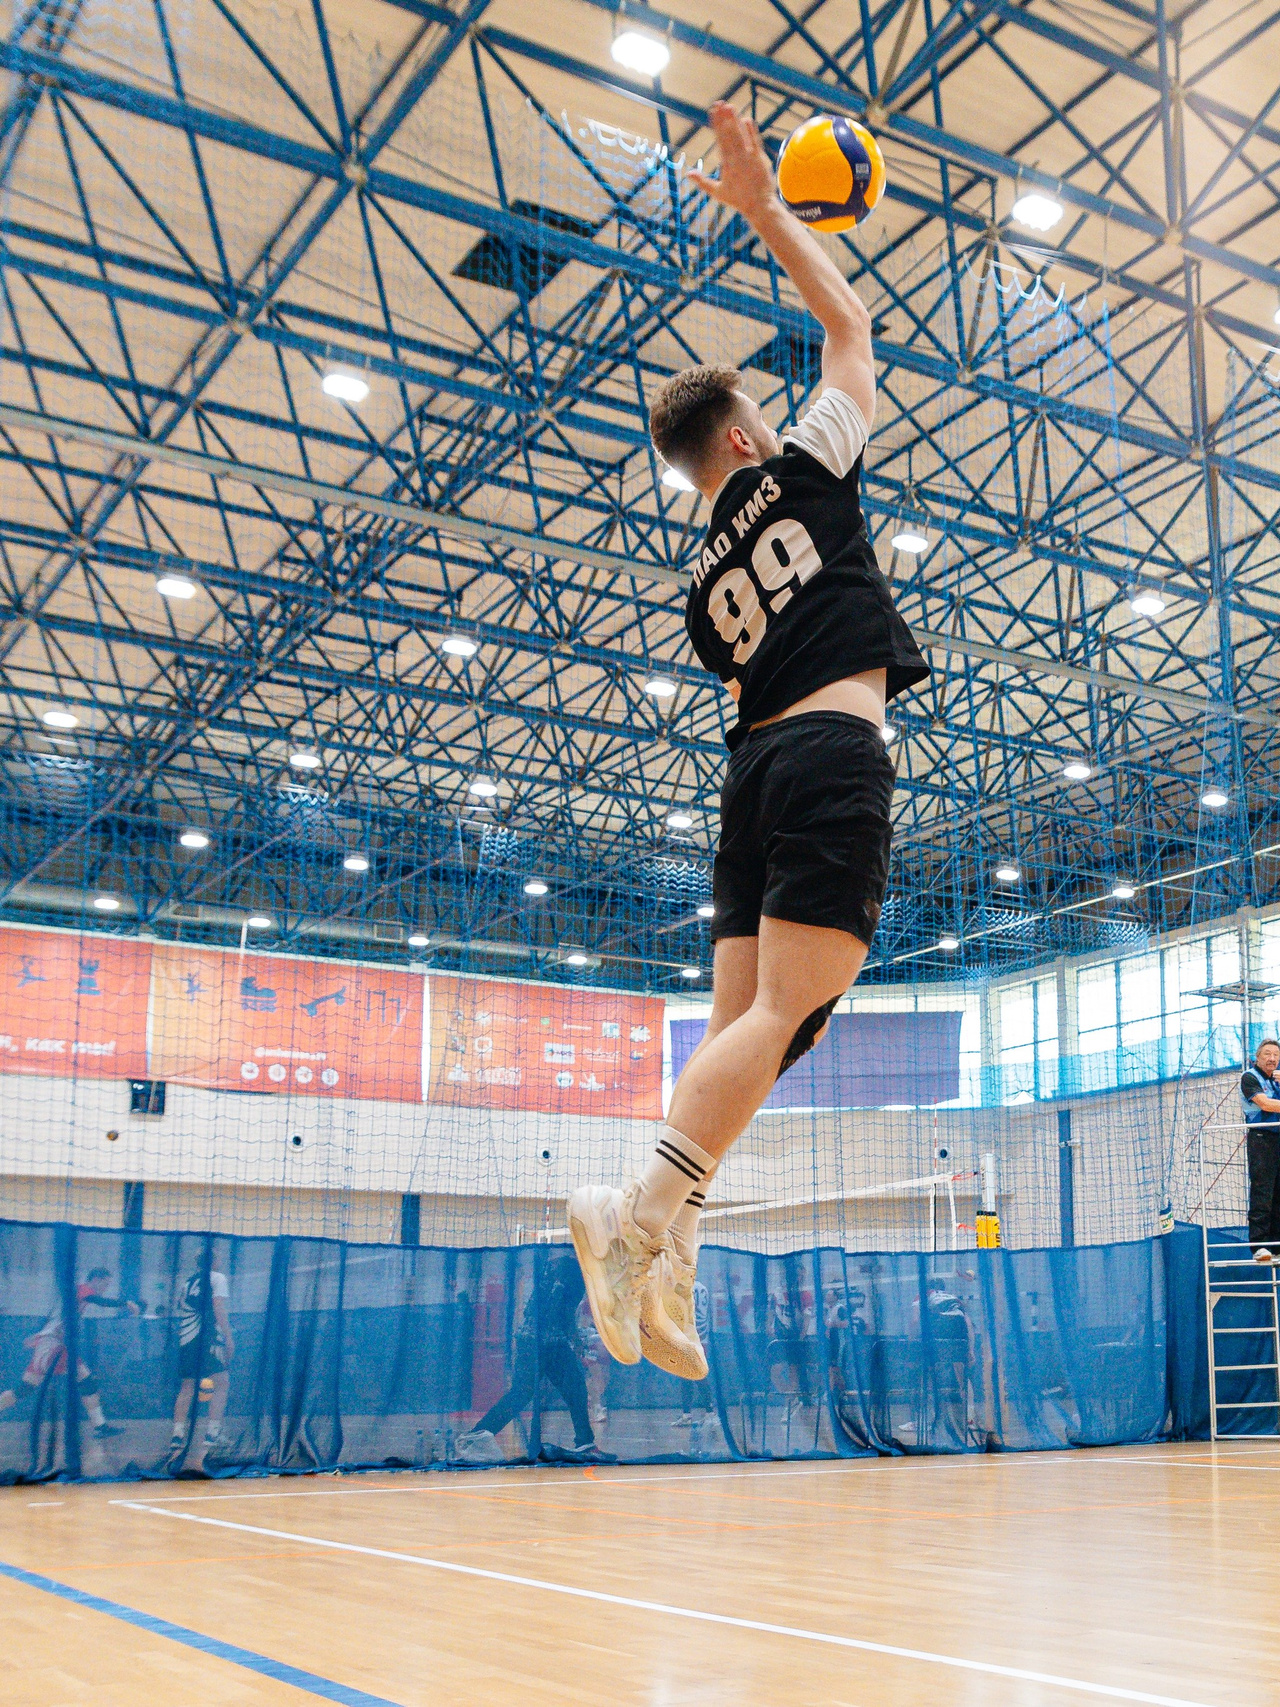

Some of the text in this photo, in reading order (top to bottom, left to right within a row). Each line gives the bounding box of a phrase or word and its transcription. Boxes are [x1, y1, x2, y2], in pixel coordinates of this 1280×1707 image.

[693, 476, 782, 589] ПАО КМЗ
[707, 518, 823, 665] 99
